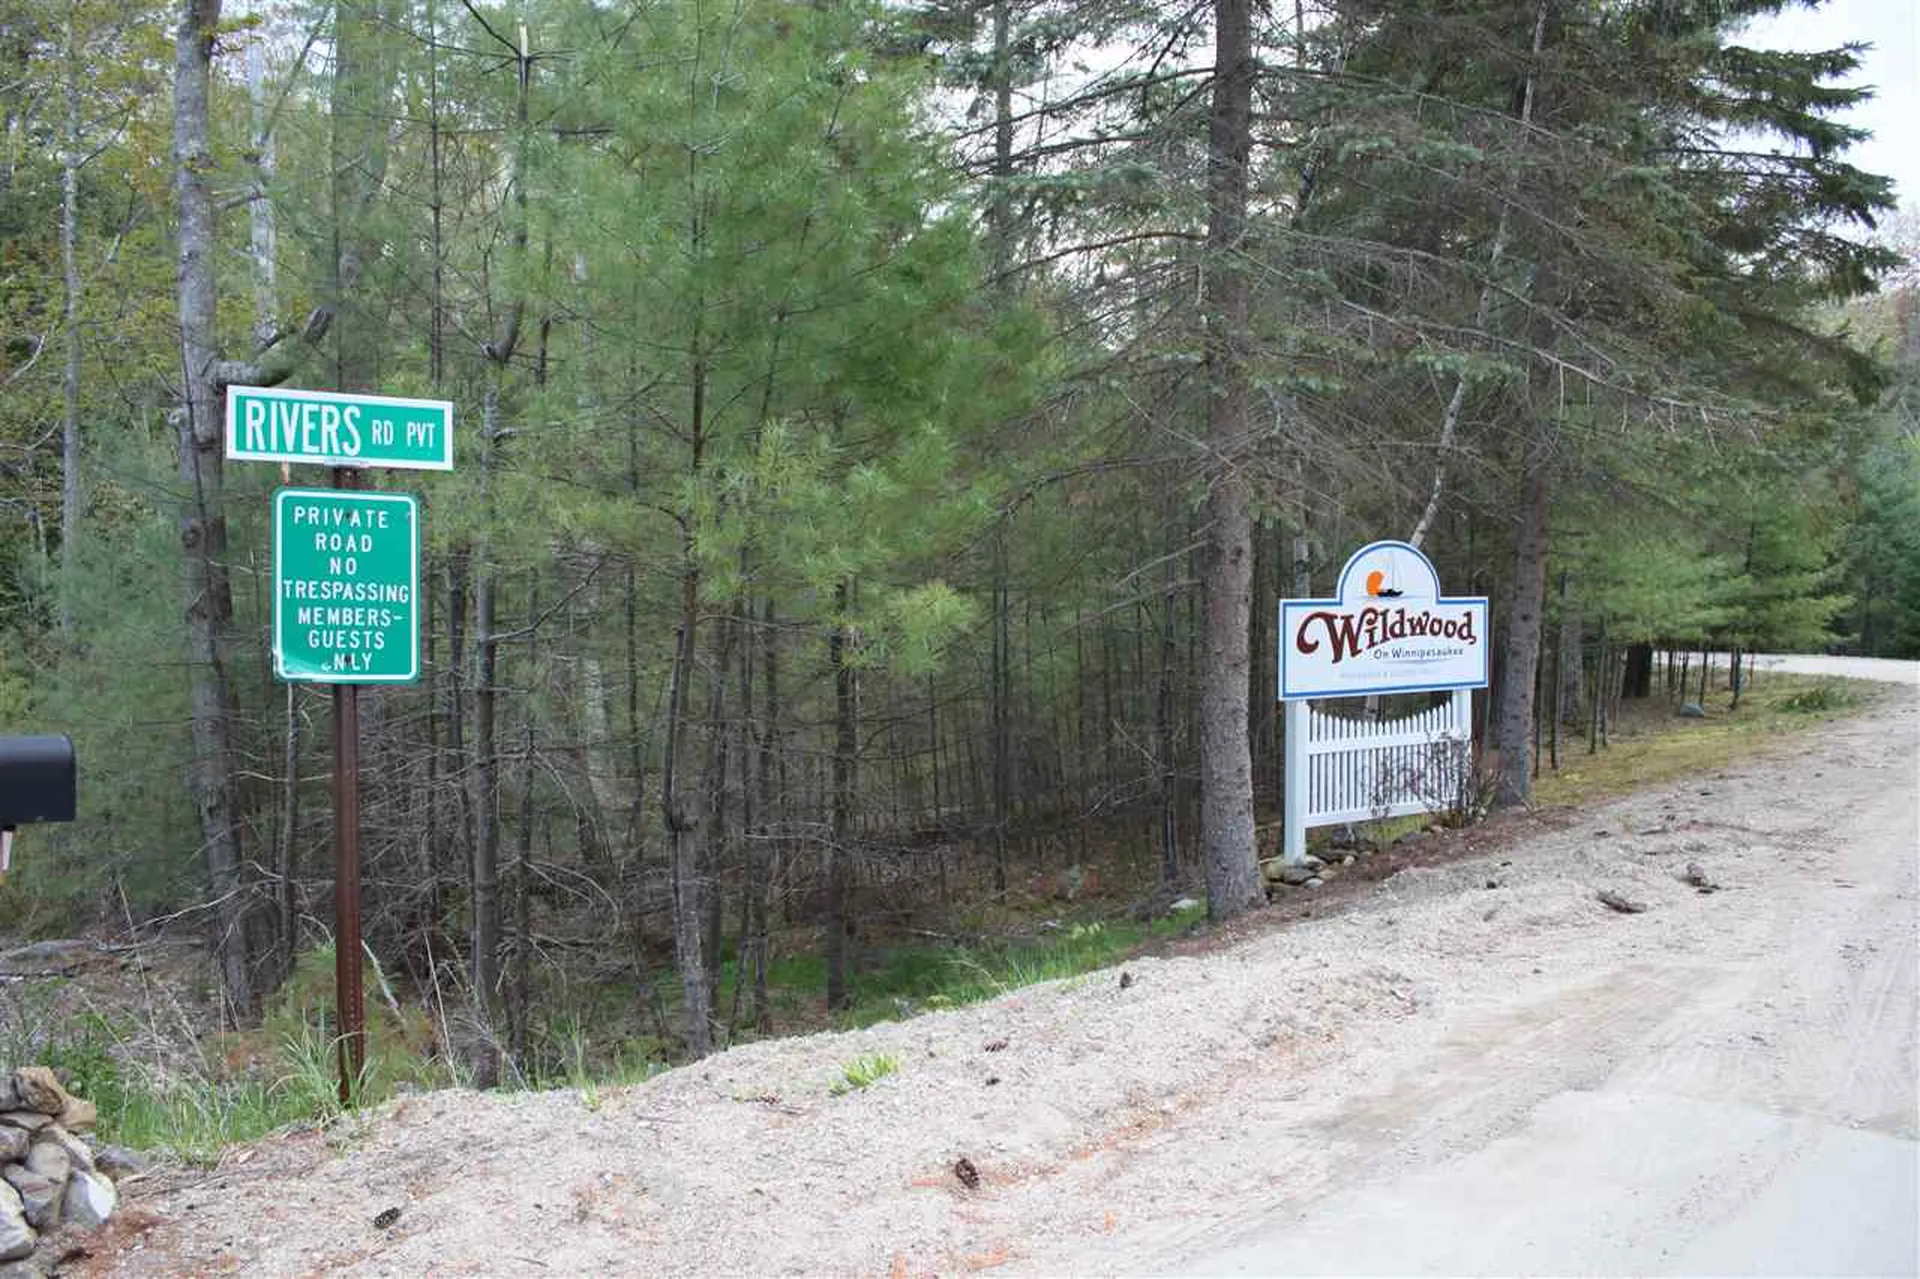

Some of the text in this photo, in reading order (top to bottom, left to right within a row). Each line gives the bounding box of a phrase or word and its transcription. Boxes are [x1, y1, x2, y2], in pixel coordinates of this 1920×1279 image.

[245, 399, 436, 456] RIVERS RD PVT
[294, 506, 389, 529] PRIVATE
[315, 534, 372, 553] ROAD
[330, 557, 357, 575] NO
[283, 580, 409, 602] TRESPASSING
[298, 608, 403, 628] MEMBERS-
[309, 630, 385, 650] GUESTS
[1296, 607, 1477, 664] Wildwood
[1374, 647, 1464, 660] On Winnipesaukee
